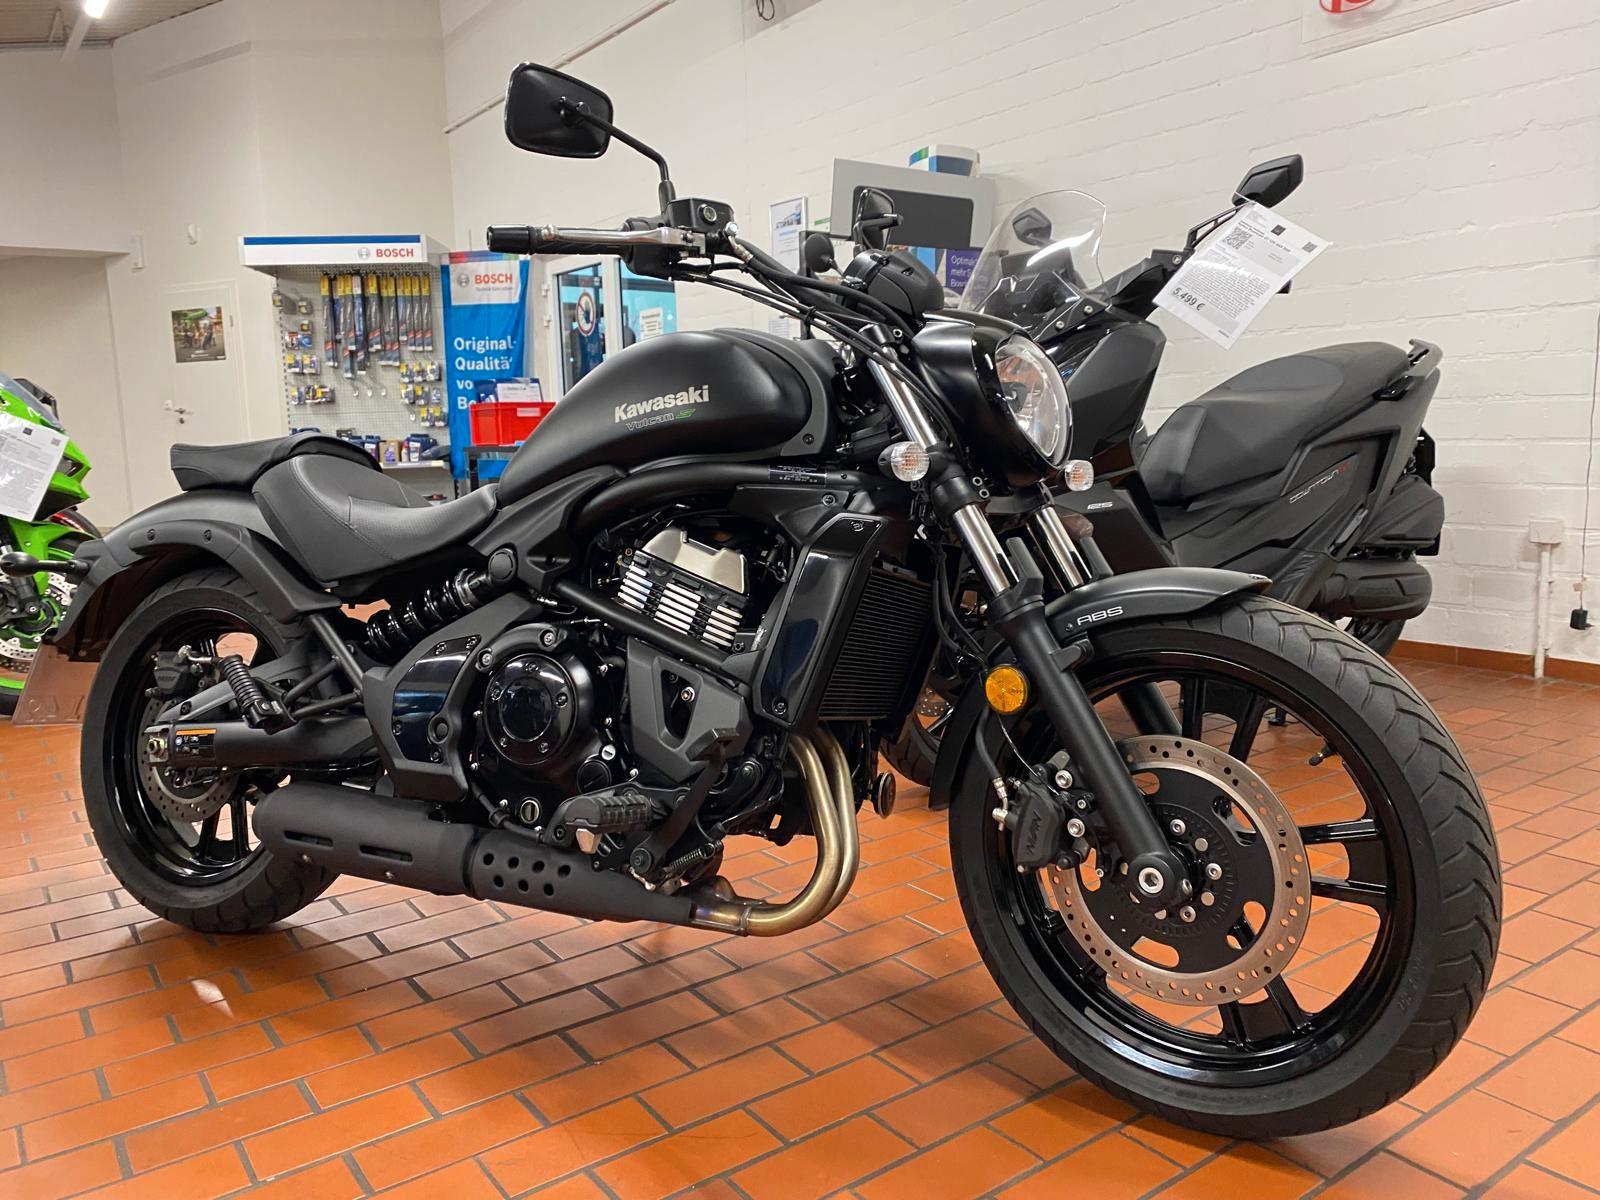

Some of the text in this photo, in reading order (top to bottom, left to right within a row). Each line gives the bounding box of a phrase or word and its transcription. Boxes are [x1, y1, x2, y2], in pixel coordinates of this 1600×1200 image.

[376, 248, 414, 257] BOSCH
[474, 273, 513, 285] BOSCH
[1173, 287, 1206, 311] 5.499 €
[614, 385, 709, 423] Kawasaki
[675, 408, 696, 419] S
[1077, 606, 1123, 626] ABS
